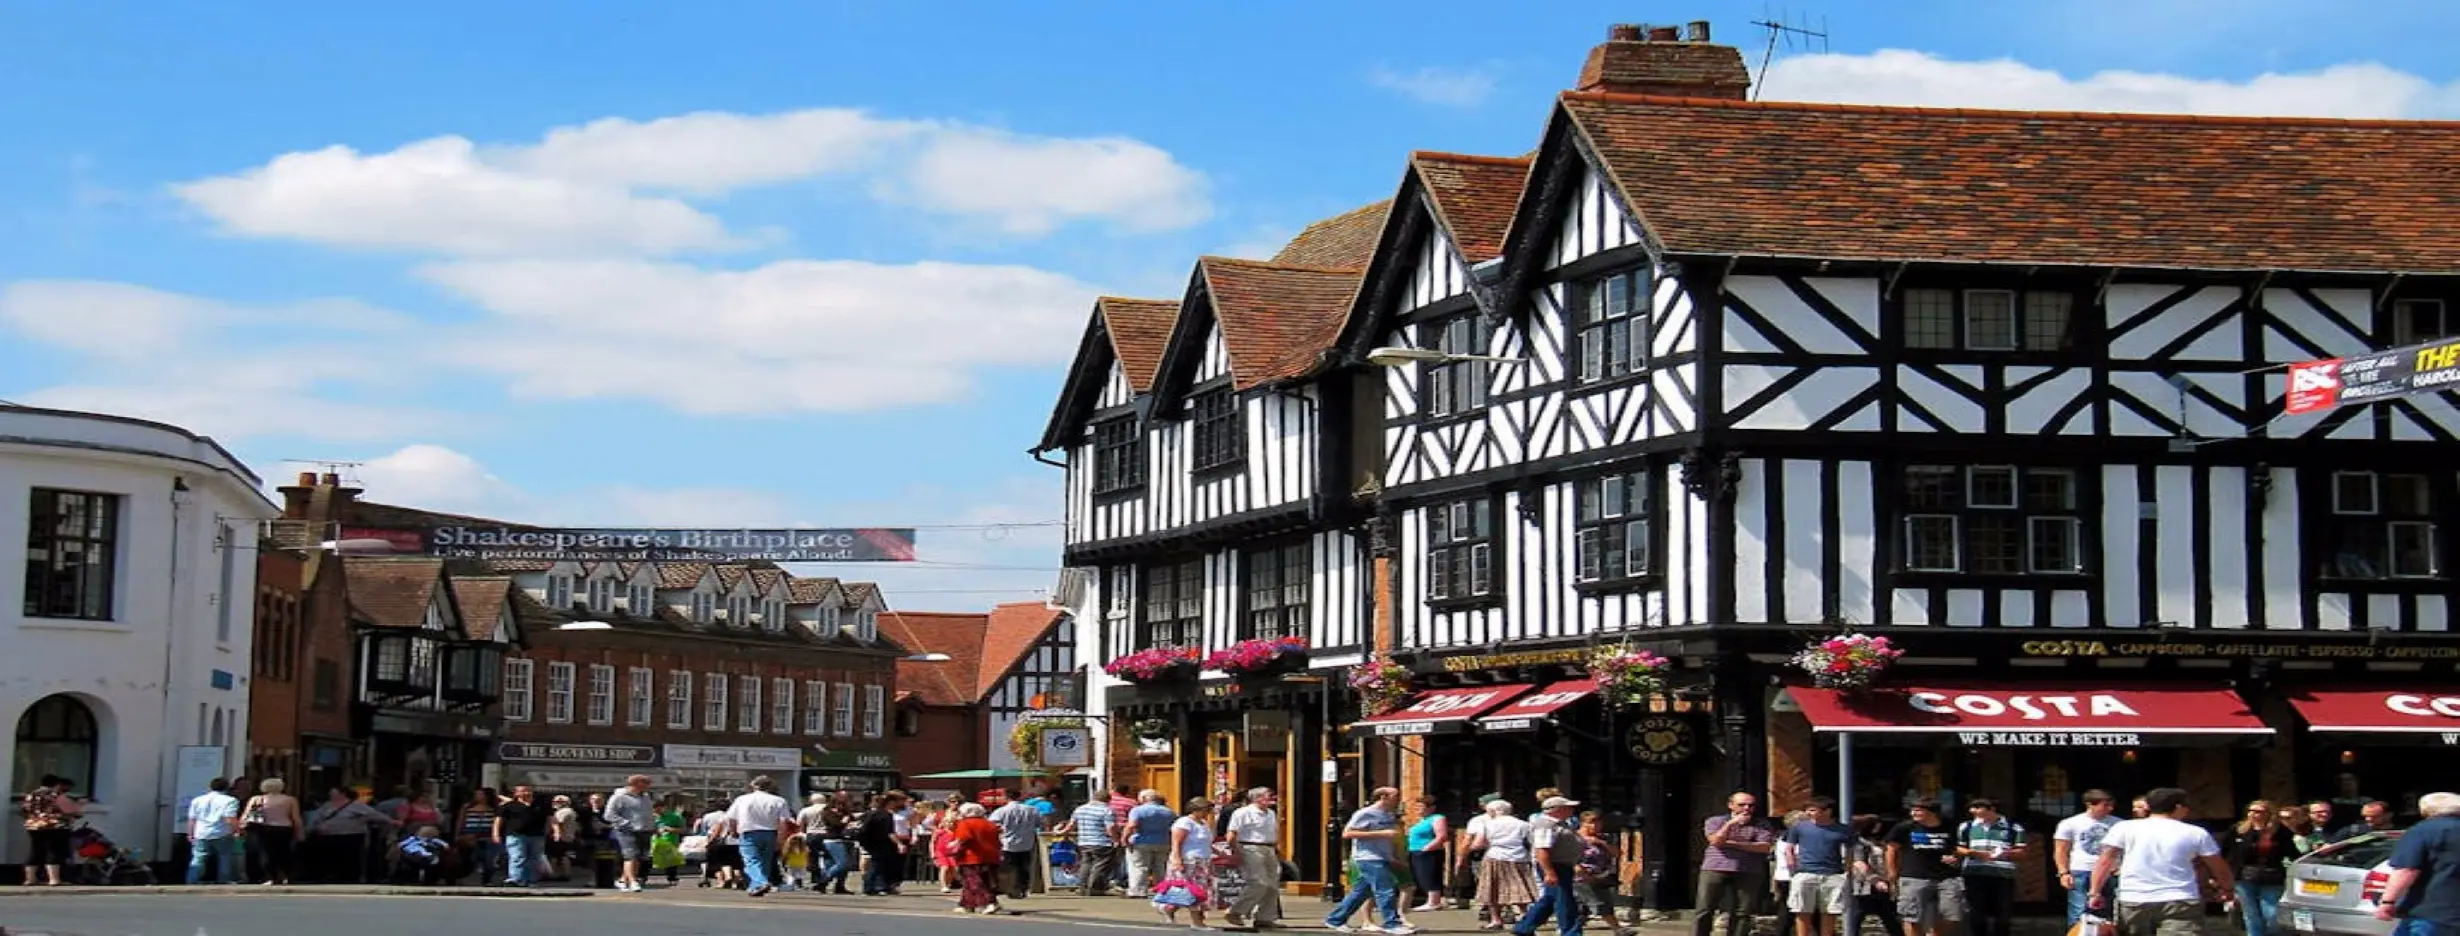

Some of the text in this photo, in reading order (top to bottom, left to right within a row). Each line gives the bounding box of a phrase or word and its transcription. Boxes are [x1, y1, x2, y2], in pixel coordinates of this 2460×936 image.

[2414, 343, 2460, 372] THE
[433, 526, 670, 551] Shakespeare's
[680, 529, 853, 553] Birthplace
[433, 548, 476, 558] Live
[481, 548, 624, 560] performances
[628, 549, 648, 560] of
[786, 549, 854, 560] Aloud!
[2022, 640, 2109, 656] COSTA
[2119, 643, 2206, 656] CAPPUCCINO
[2309, 644, 2374, 657] ESPRESSO
[1908, 692, 2141, 720] COSTA
[1635, 717, 1687, 734] COSTA
[1959, 732, 2140, 746] WE MAKE IT BETTER
[521, 745, 546, 758] THE
